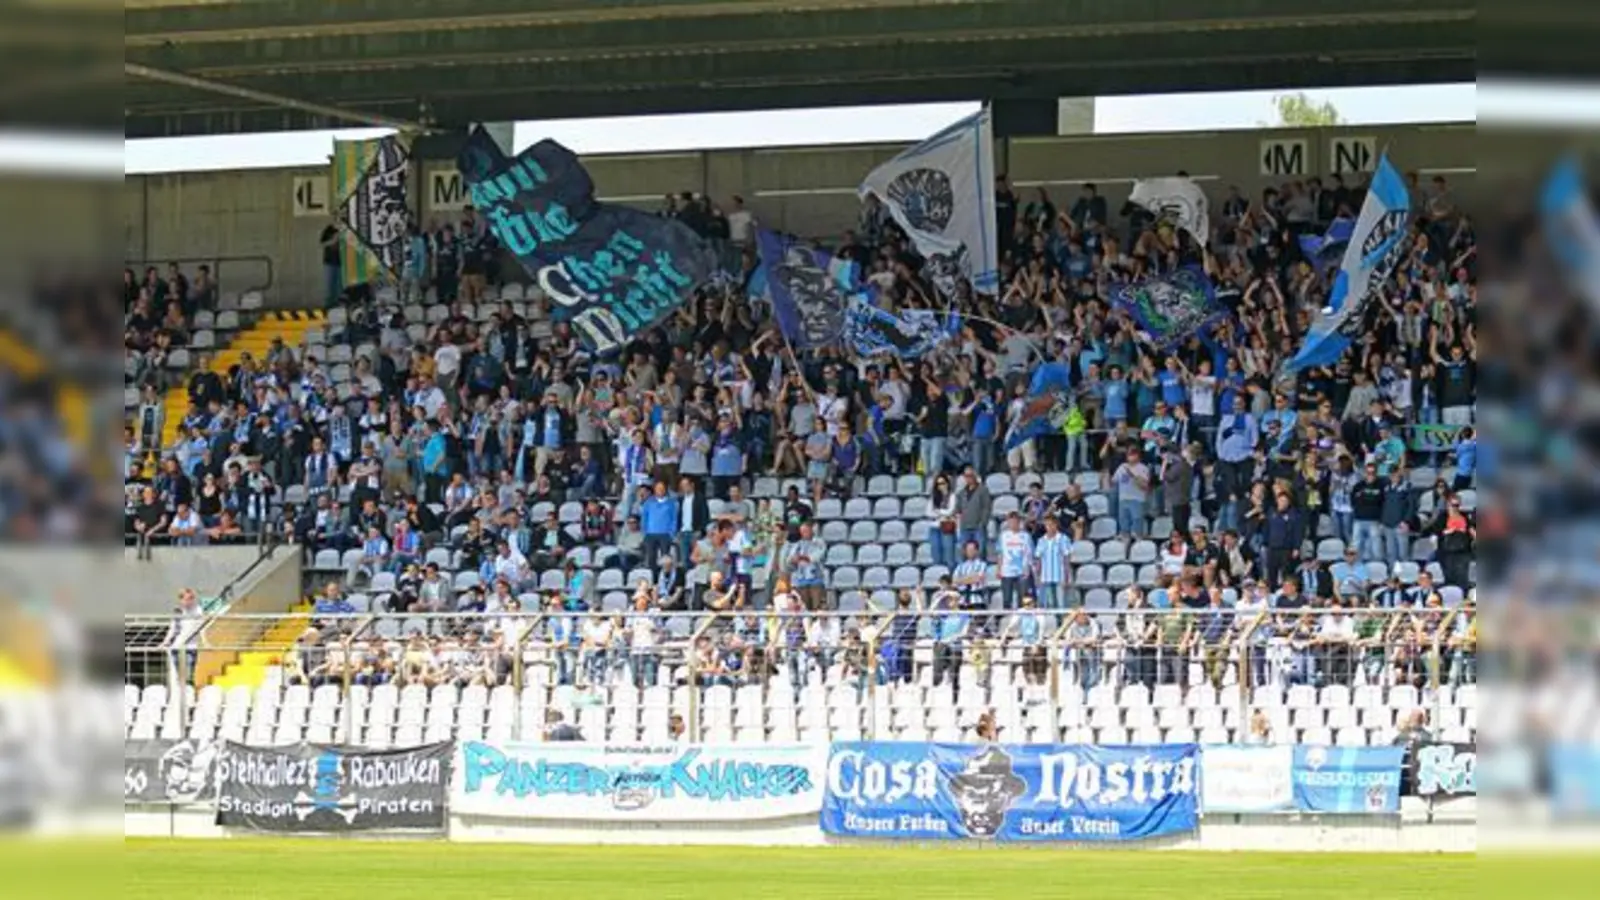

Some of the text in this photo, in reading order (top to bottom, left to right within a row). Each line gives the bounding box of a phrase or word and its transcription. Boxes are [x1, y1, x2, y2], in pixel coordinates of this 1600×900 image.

[1274, 144, 1302, 174] M
[1336, 142, 1359, 171] N
[306, 180, 323, 209] L
[434, 175, 460, 203] M
[351, 752, 439, 789] Rabauken
[463, 740, 616, 798] PANZER
[660, 747, 814, 801] KNACKER
[828, 750, 939, 807] Cosa
[1033, 751, 1195, 809] Nostra
[220, 796, 433, 818] Stadion Piraten
